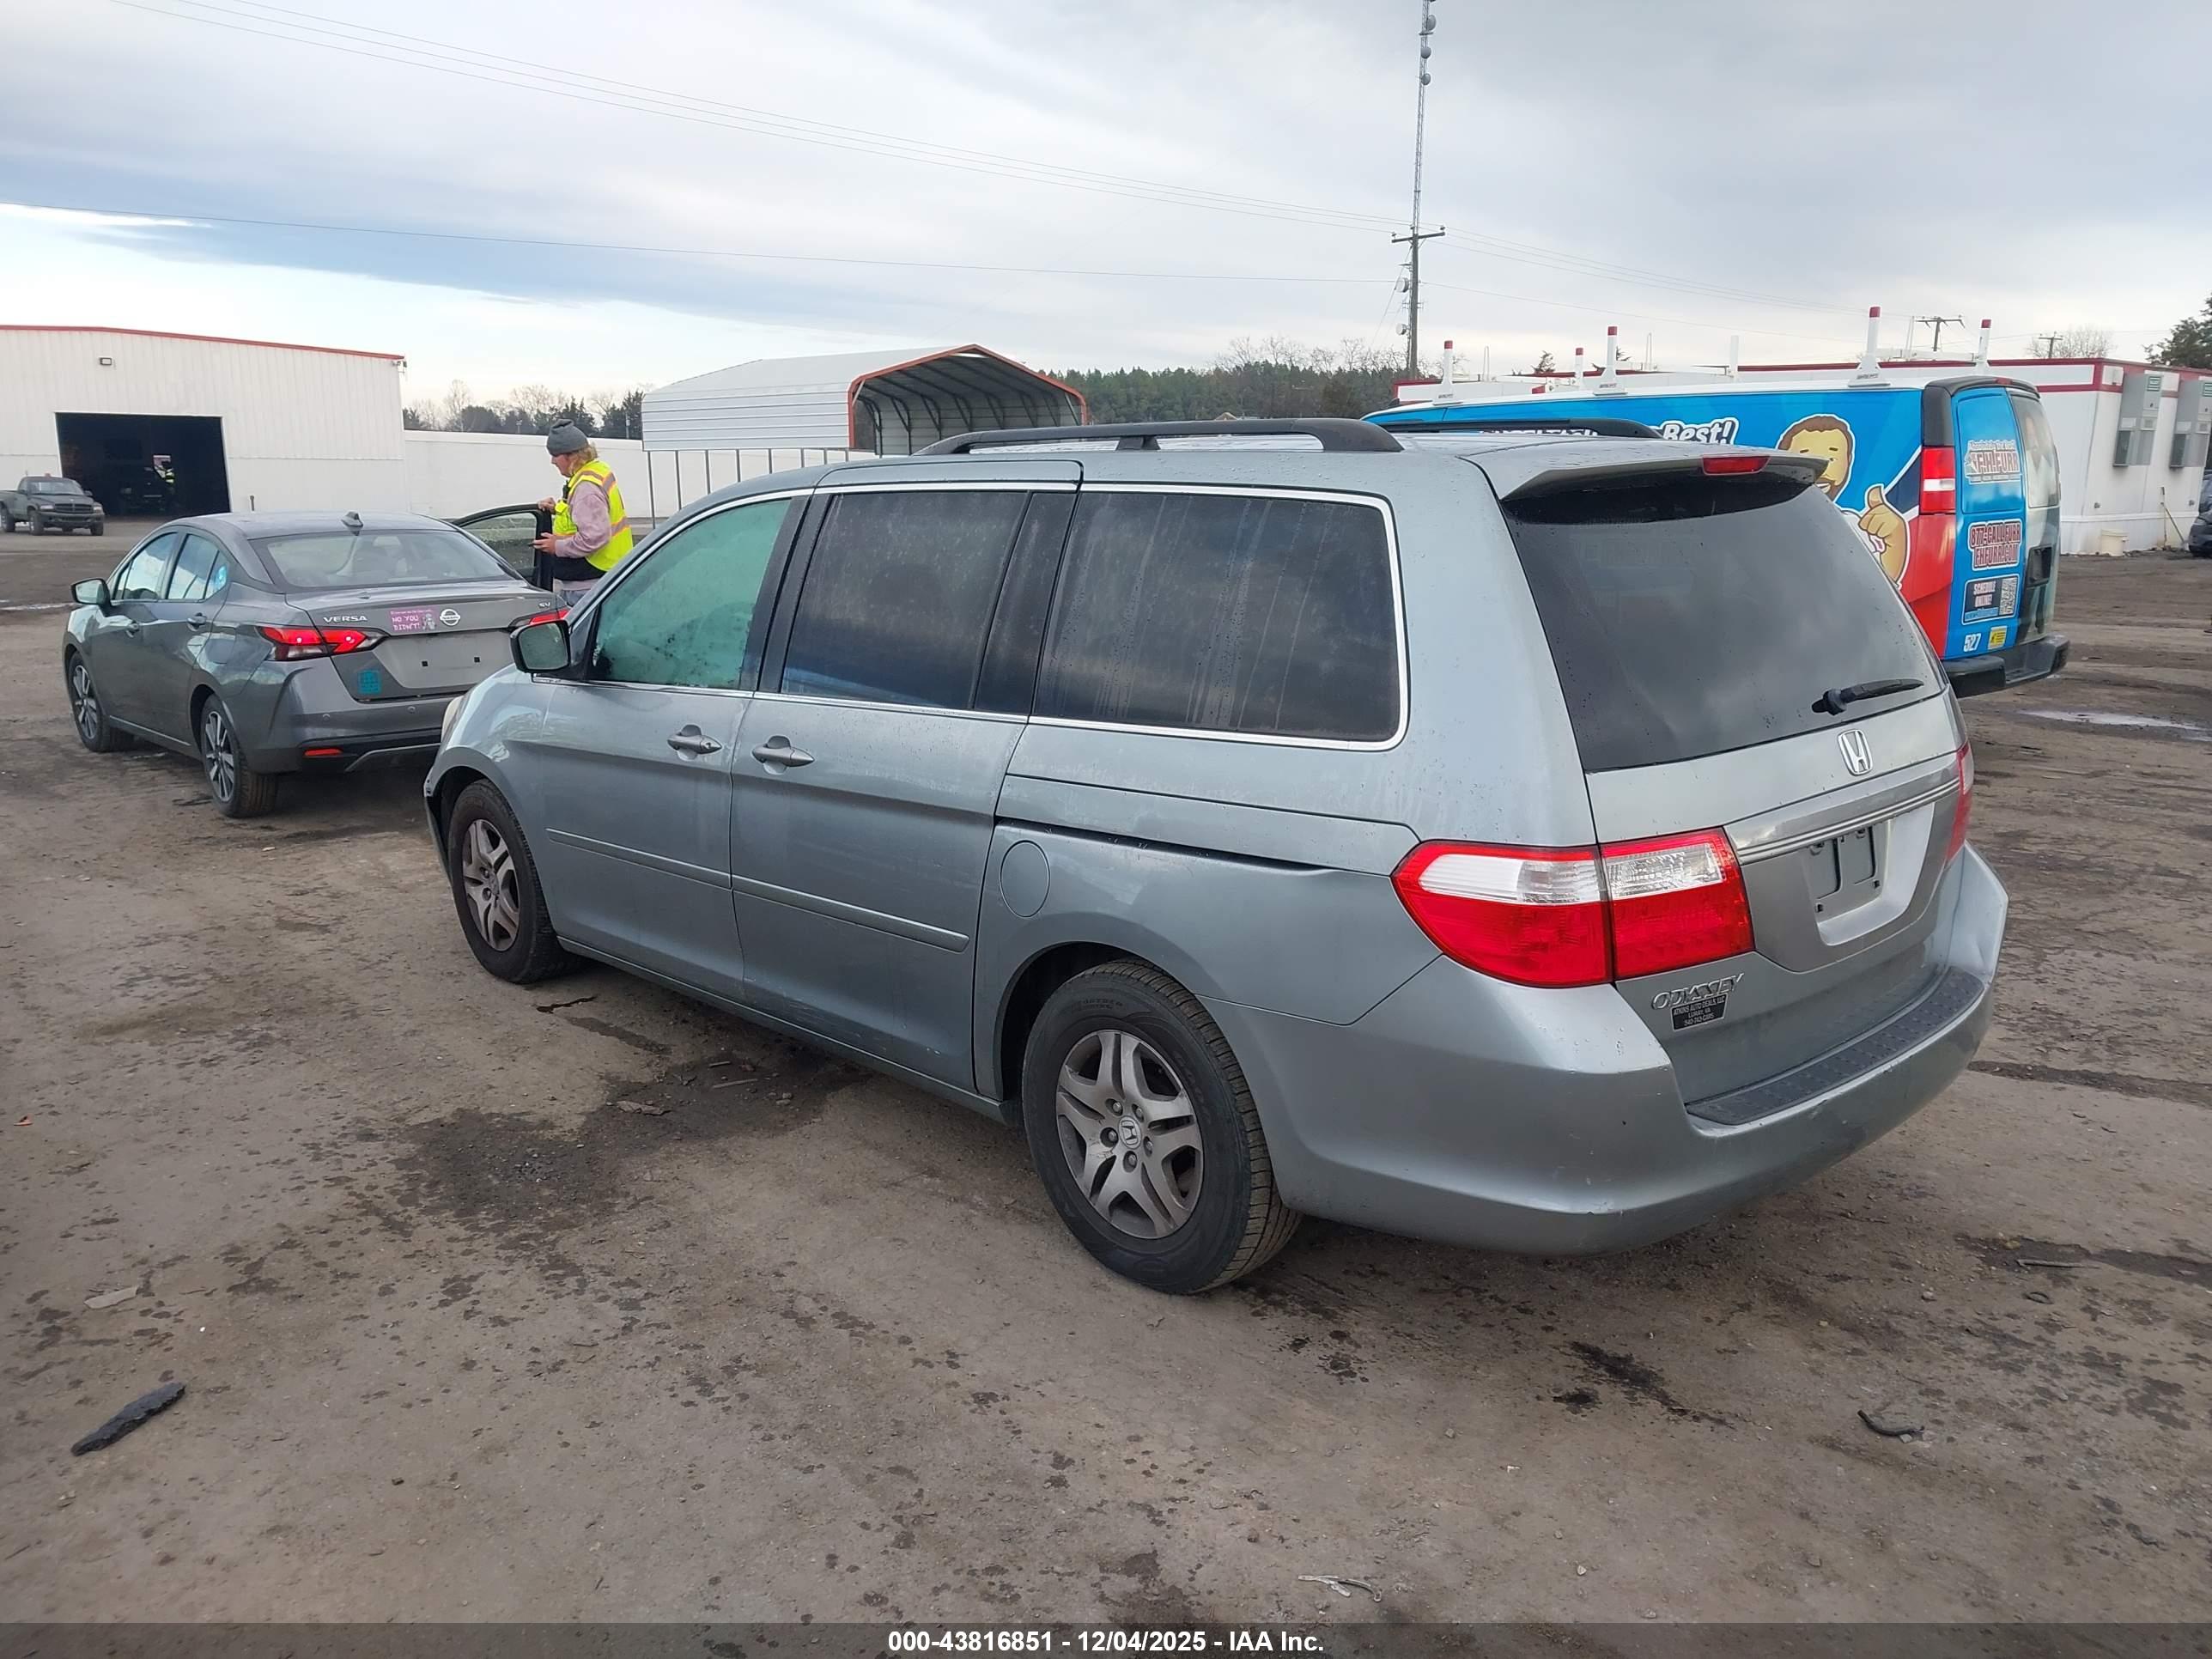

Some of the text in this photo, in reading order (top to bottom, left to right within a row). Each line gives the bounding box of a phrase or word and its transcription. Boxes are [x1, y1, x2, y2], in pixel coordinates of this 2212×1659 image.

[1662, 421, 1732, 445] Best!
[1963, 633, 1982, 652] 527
[1650, 972, 1744, 1009] ODYSSEY
[1690, 1003, 1702, 1012] AUTO
